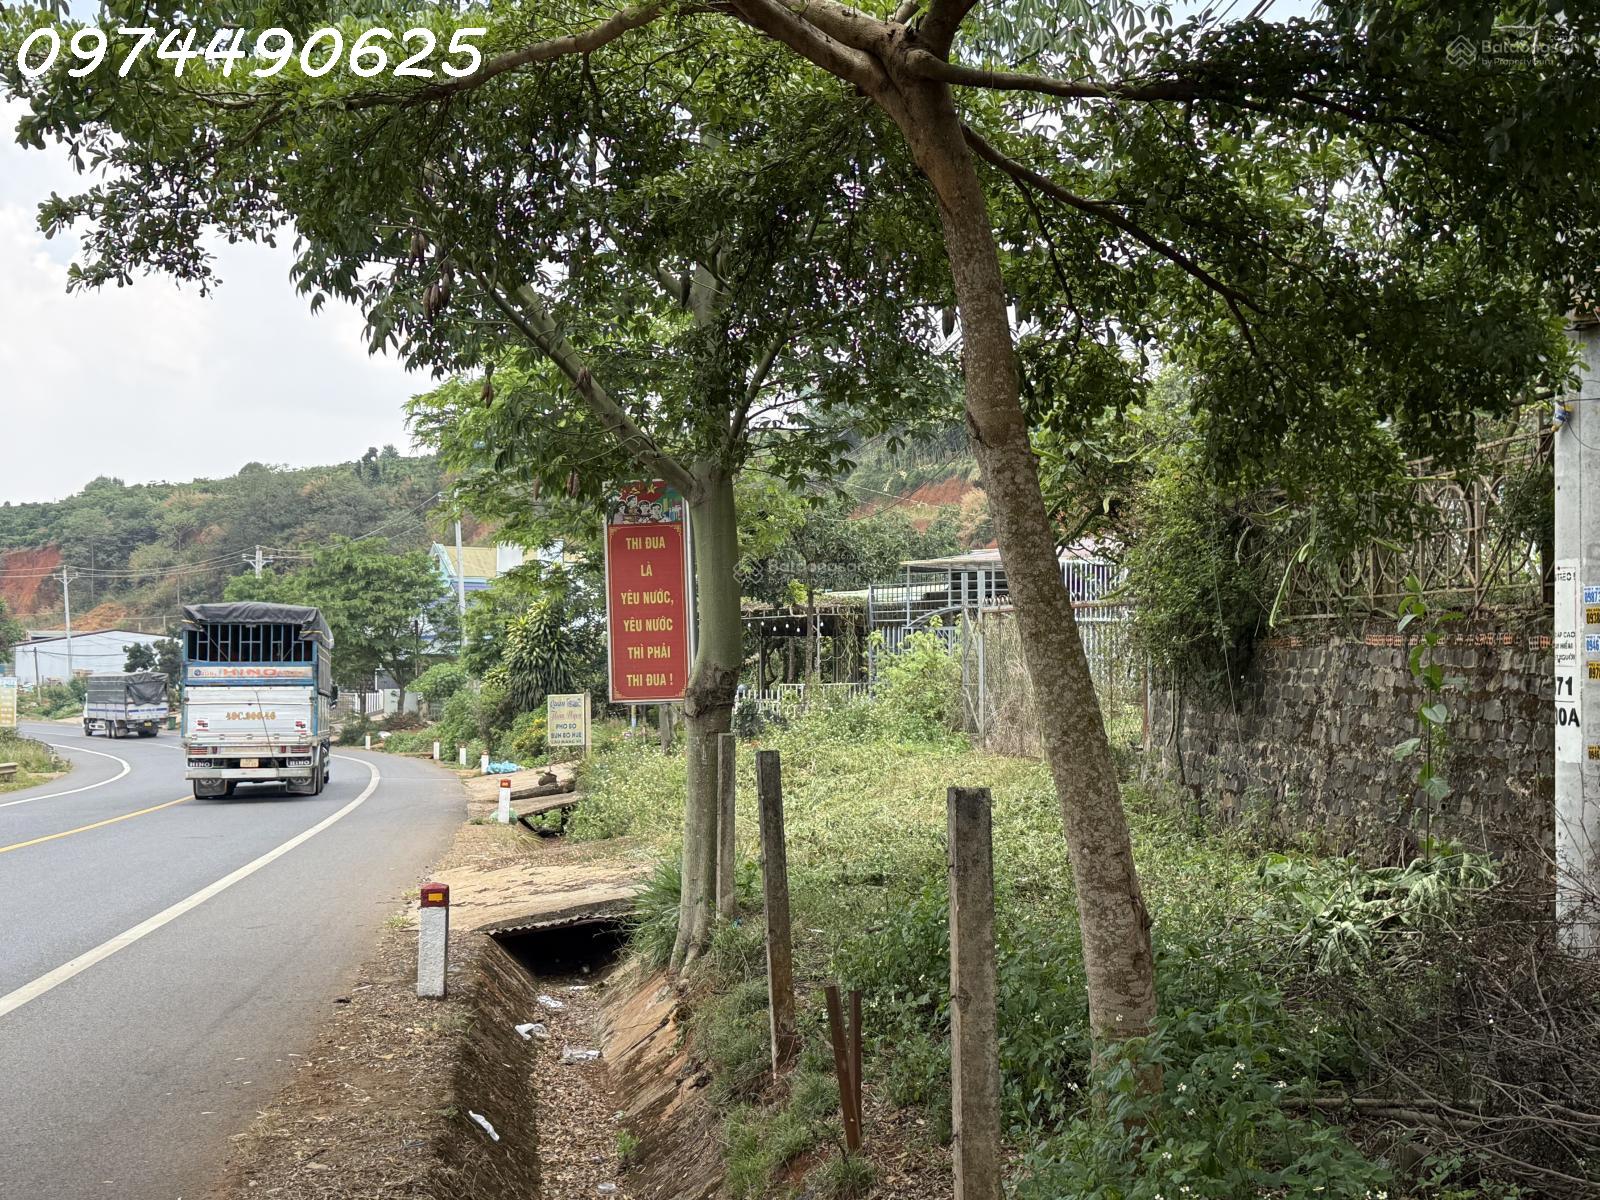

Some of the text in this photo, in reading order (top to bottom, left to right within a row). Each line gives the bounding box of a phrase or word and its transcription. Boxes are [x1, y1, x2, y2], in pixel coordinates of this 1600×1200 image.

[626, 536, 666, 550] THI ĐUA
[640, 561, 653, 577] LÀ
[620, 589, 640, 605] YÊU
[623, 616, 673, 632] YÊU NƯỚC
[627, 642, 671, 659] THÌ PHẢI
[222, 668, 277, 677] HINO
[626, 674, 643, 687] THI
[645, 673, 667, 686] ĐUA
